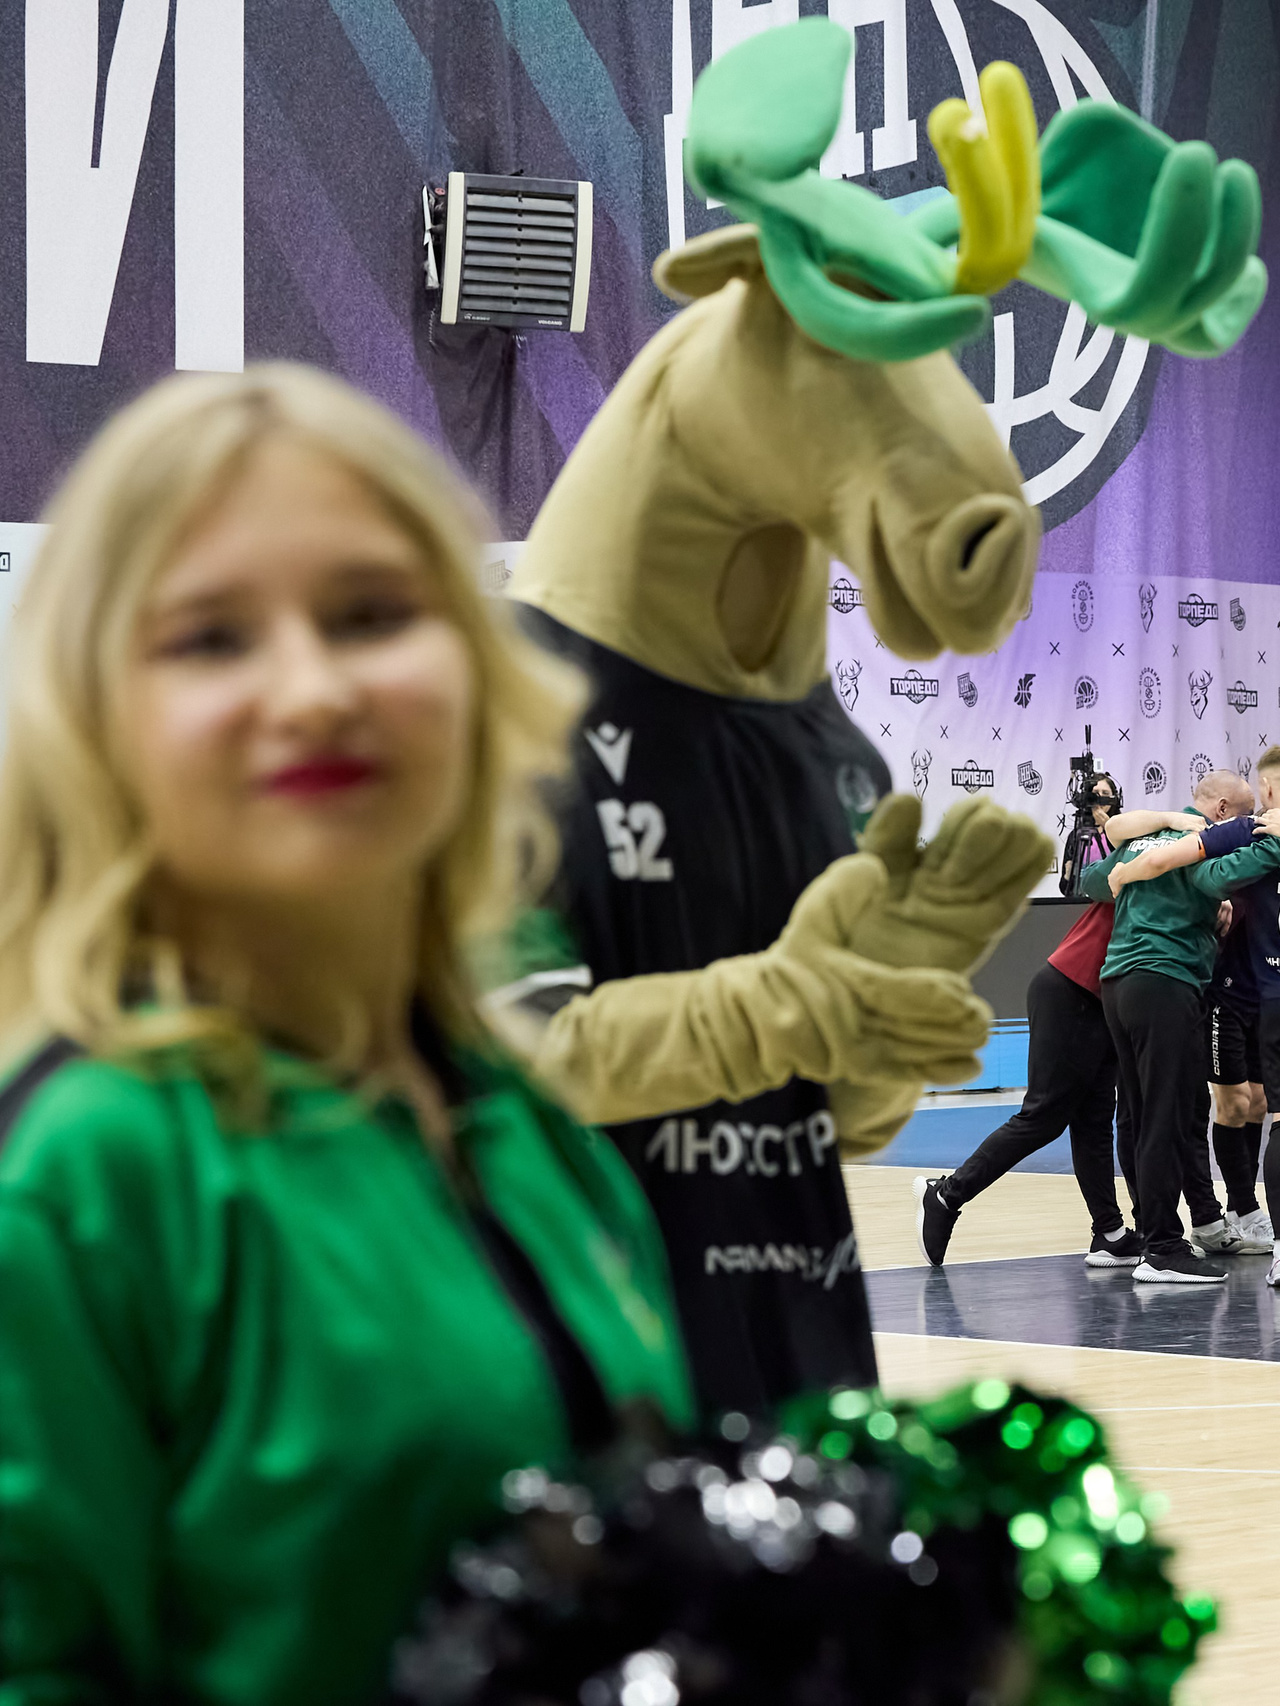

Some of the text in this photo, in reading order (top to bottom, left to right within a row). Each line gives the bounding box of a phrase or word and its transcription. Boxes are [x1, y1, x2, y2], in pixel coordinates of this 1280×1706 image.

[1180, 604, 1218, 618] ТОРПЕДО
[891, 679, 939, 696] ТОРПЕДО
[1228, 690, 1257, 706] ТОРПЕДО
[952, 770, 994, 786] ТОРПЕДО
[596, 798, 674, 881] 52
